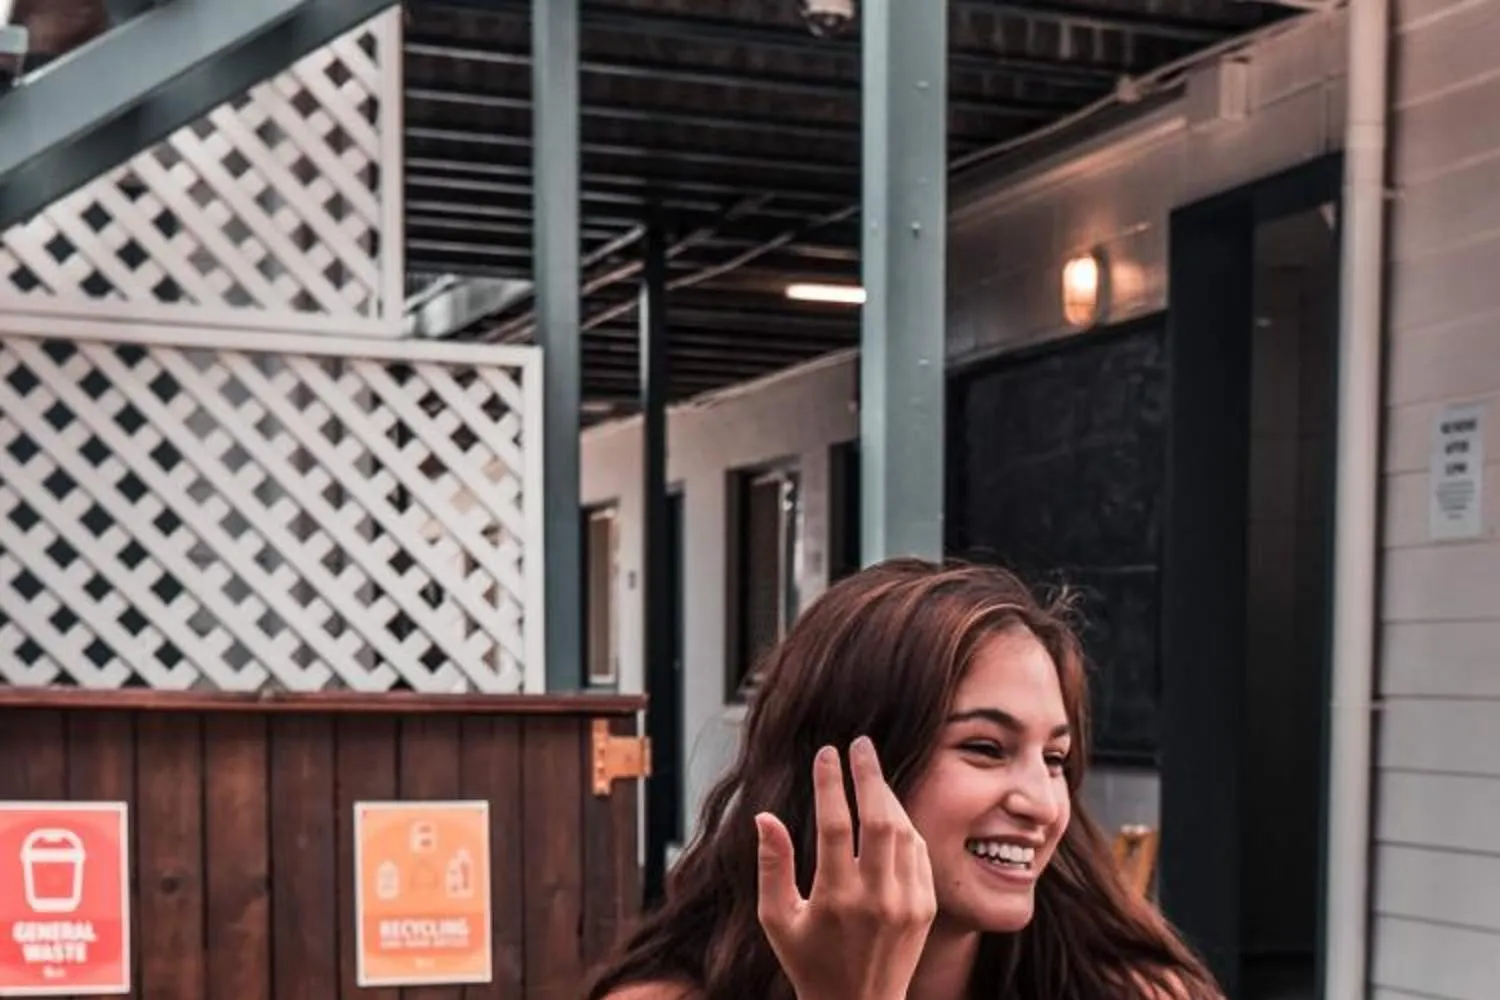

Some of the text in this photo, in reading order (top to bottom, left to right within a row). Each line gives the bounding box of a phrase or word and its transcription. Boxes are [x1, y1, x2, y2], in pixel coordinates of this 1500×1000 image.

[12, 919, 98, 942] GENERAL
[378, 916, 470, 936] RECYCLING
[23, 941, 88, 964] WASTE
